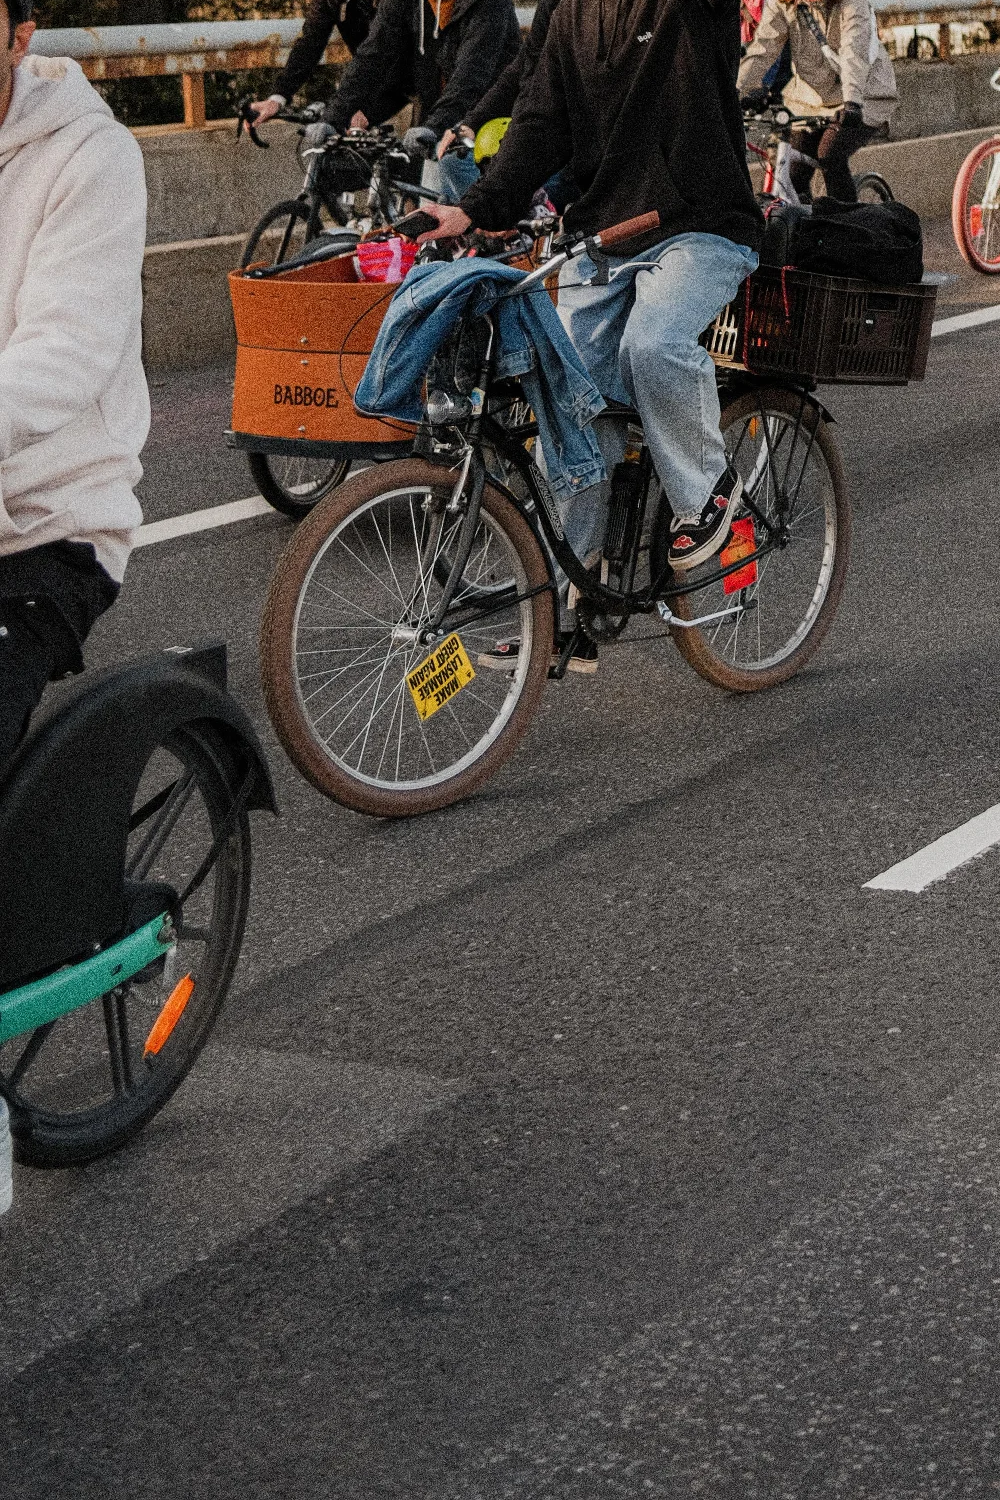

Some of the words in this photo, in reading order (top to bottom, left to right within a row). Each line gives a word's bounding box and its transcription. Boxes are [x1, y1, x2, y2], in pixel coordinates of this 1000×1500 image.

[274, 384, 339, 408] BABBOE
[436, 636, 460, 668] GREAT
[409, 658, 436, 690] AGAIN
[418, 654, 463, 701] LASNAMÄE
[434, 676, 460, 706] MAKE
